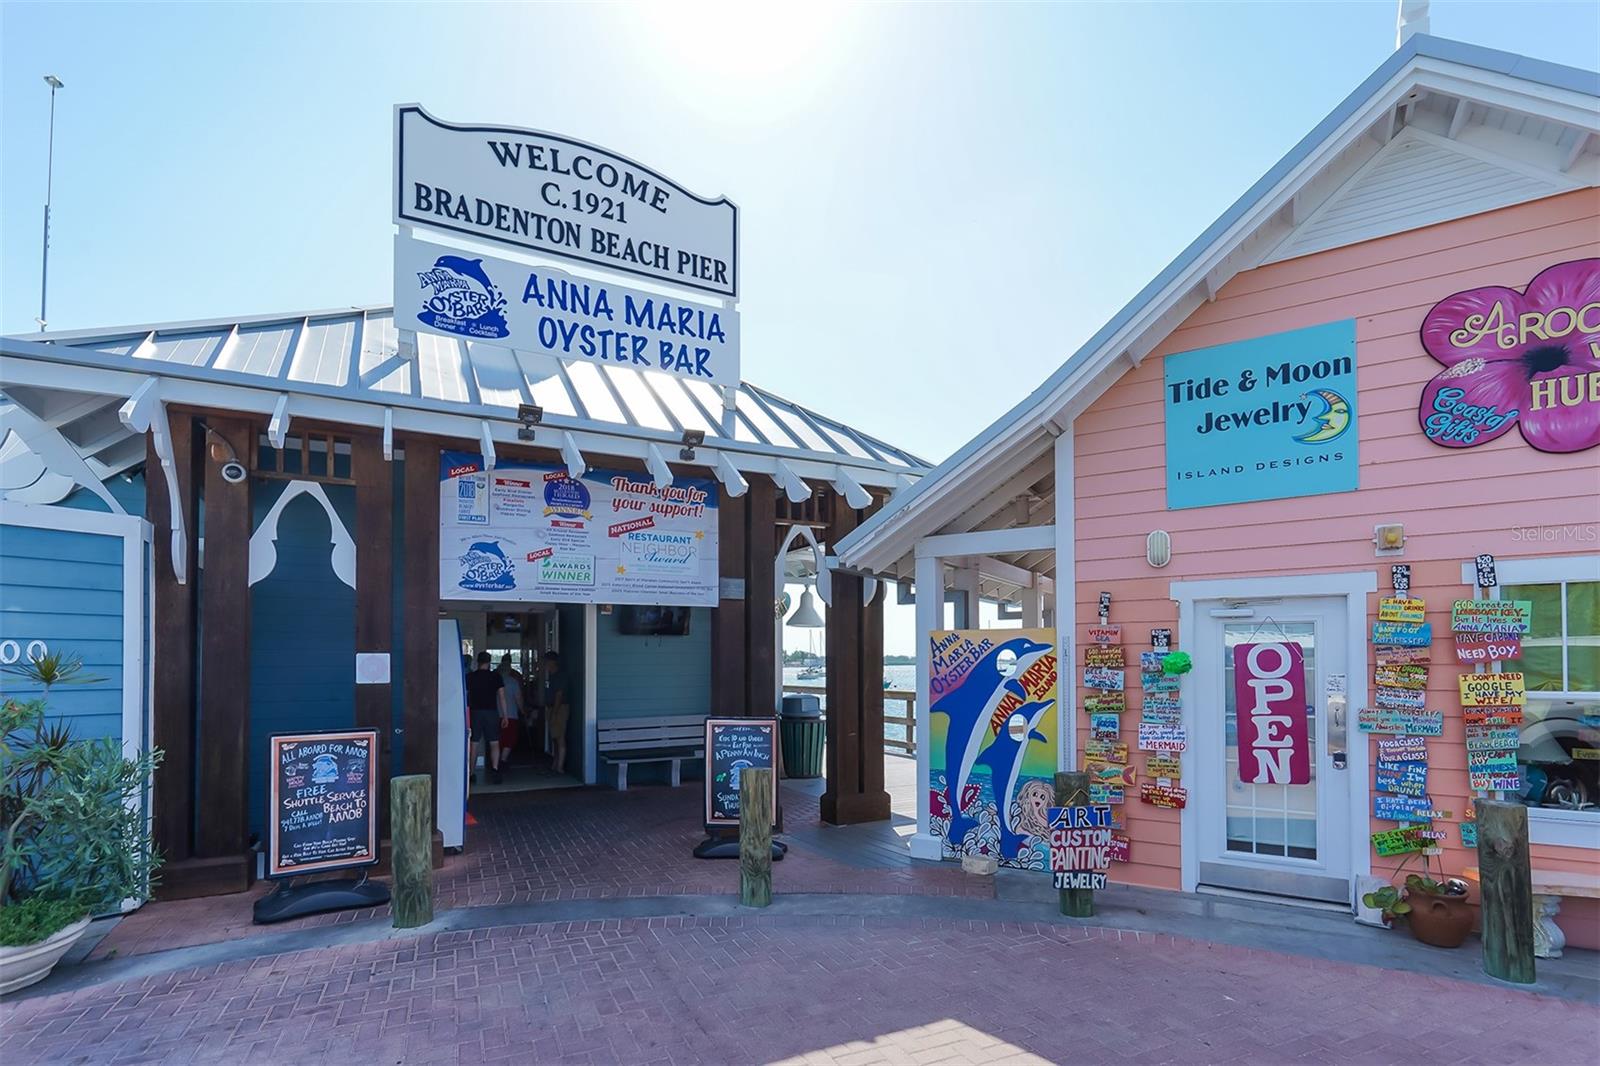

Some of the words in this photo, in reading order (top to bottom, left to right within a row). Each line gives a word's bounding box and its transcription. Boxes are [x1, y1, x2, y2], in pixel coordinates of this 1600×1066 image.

[487, 140, 670, 213] WELCOME
[541, 182, 627, 223] C.1921
[414, 182, 582, 249] BRADENTON
[590, 227, 669, 271] BEACH
[677, 250, 728, 285] PIER
[429, 290, 488, 312] OYSTER
[452, 300, 488, 317] BAR
[522, 273, 613, 322] ANNA
[624, 295, 726, 343] MARIA
[434, 320, 456, 330] Dinner
[479, 323, 499, 332] Lunch
[538, 316, 650, 366] OYSTER
[659, 340, 714, 378] BAR
[1168, 377, 1229, 404] Tide
[1238, 369, 1257, 392] &
[1266, 356, 1351, 387] Moon
[1197, 400, 1312, 434] Jewelry
[1425, 411, 1481, 444] Gifts
[451, 466, 475, 475] LOCAL
[1177, 465, 1244, 480] ISLAND
[1256, 452, 1344, 471] DESIGNS
[545, 472, 566, 480] LOCAL
[611, 476, 658, 495] Thank
[661, 485, 687, 501] you
[686, 485, 707, 504] for
[612, 497, 645, 513] your
[649, 501, 704, 519] support!
[610, 518, 653, 535] NATIONAL
[628, 532, 692, 544] RESTAURANT
[529, 549, 551, 560] LOCAL
[622, 542, 698, 558] NEIGHBOR
[637, 551, 692, 565] Award
[466, 562, 504, 580] OYSTER
[552, 562, 591, 570] AWARDS
[480, 569, 503, 581] BAR
[542, 570, 591, 581] WINNER
[1454, 600, 1474, 608] GOD
[1475, 600, 1514, 609] created
[1480, 623, 1520, 632] MARIA
[1456, 633, 1484, 643] HAVE
[930, 632, 961, 660] ANNA
[1457, 648, 1486, 659] NEED
[932, 637, 974, 676] MARIA
[931, 655, 975, 695] OYSTER
[970, 637, 994, 664] BAR
[1032, 670, 1058, 701] ISLAND
[1467, 682, 1513, 692] GOOGLE
[989, 691, 1024, 737] ANNA
[1018, 653, 1057, 697] MARIA
[1475, 691, 1502, 699] HAVE
[1505, 690, 1524, 698] MY
[1475, 697, 1514, 705] WIFE!
[1246, 642, 1295, 785] OPEN
[1145, 741, 1186, 751] MERMAID
[1379, 740, 1399, 748] YOGA
[1399, 737, 1425, 746] CLASS?
[282, 751, 297, 764] ALL
[298, 744, 327, 758] ABOARD
[329, 743, 343, 754] FOR
[1402, 751, 1428, 761] GLASS!
[1378, 762, 1400, 771] LIKE
[1408, 764, 1427, 775] FINE
[1377, 776, 1397, 785] best
[1400, 780, 1425, 789] when
[1473, 781, 1491, 790] BUY
[1493, 780, 1520, 790] WINE
[296, 784, 328, 799] FREE
[1388, 785, 1422, 796] DRUNK
[283, 795, 326, 809] SHUTTLE
[327, 789, 366, 802] SERVICE
[291, 809, 309, 818] CALL
[323, 801, 353, 814] BEACH
[1416, 809, 1444, 818] RELAX
[1049, 805, 1111, 828] ART
[1050, 828, 1112, 847] CUSTOM
[1422, 831, 1446, 839] RELAX
[1049, 846, 1111, 870] PAINTING
[1054, 872, 1107, 889] JEWELRY
